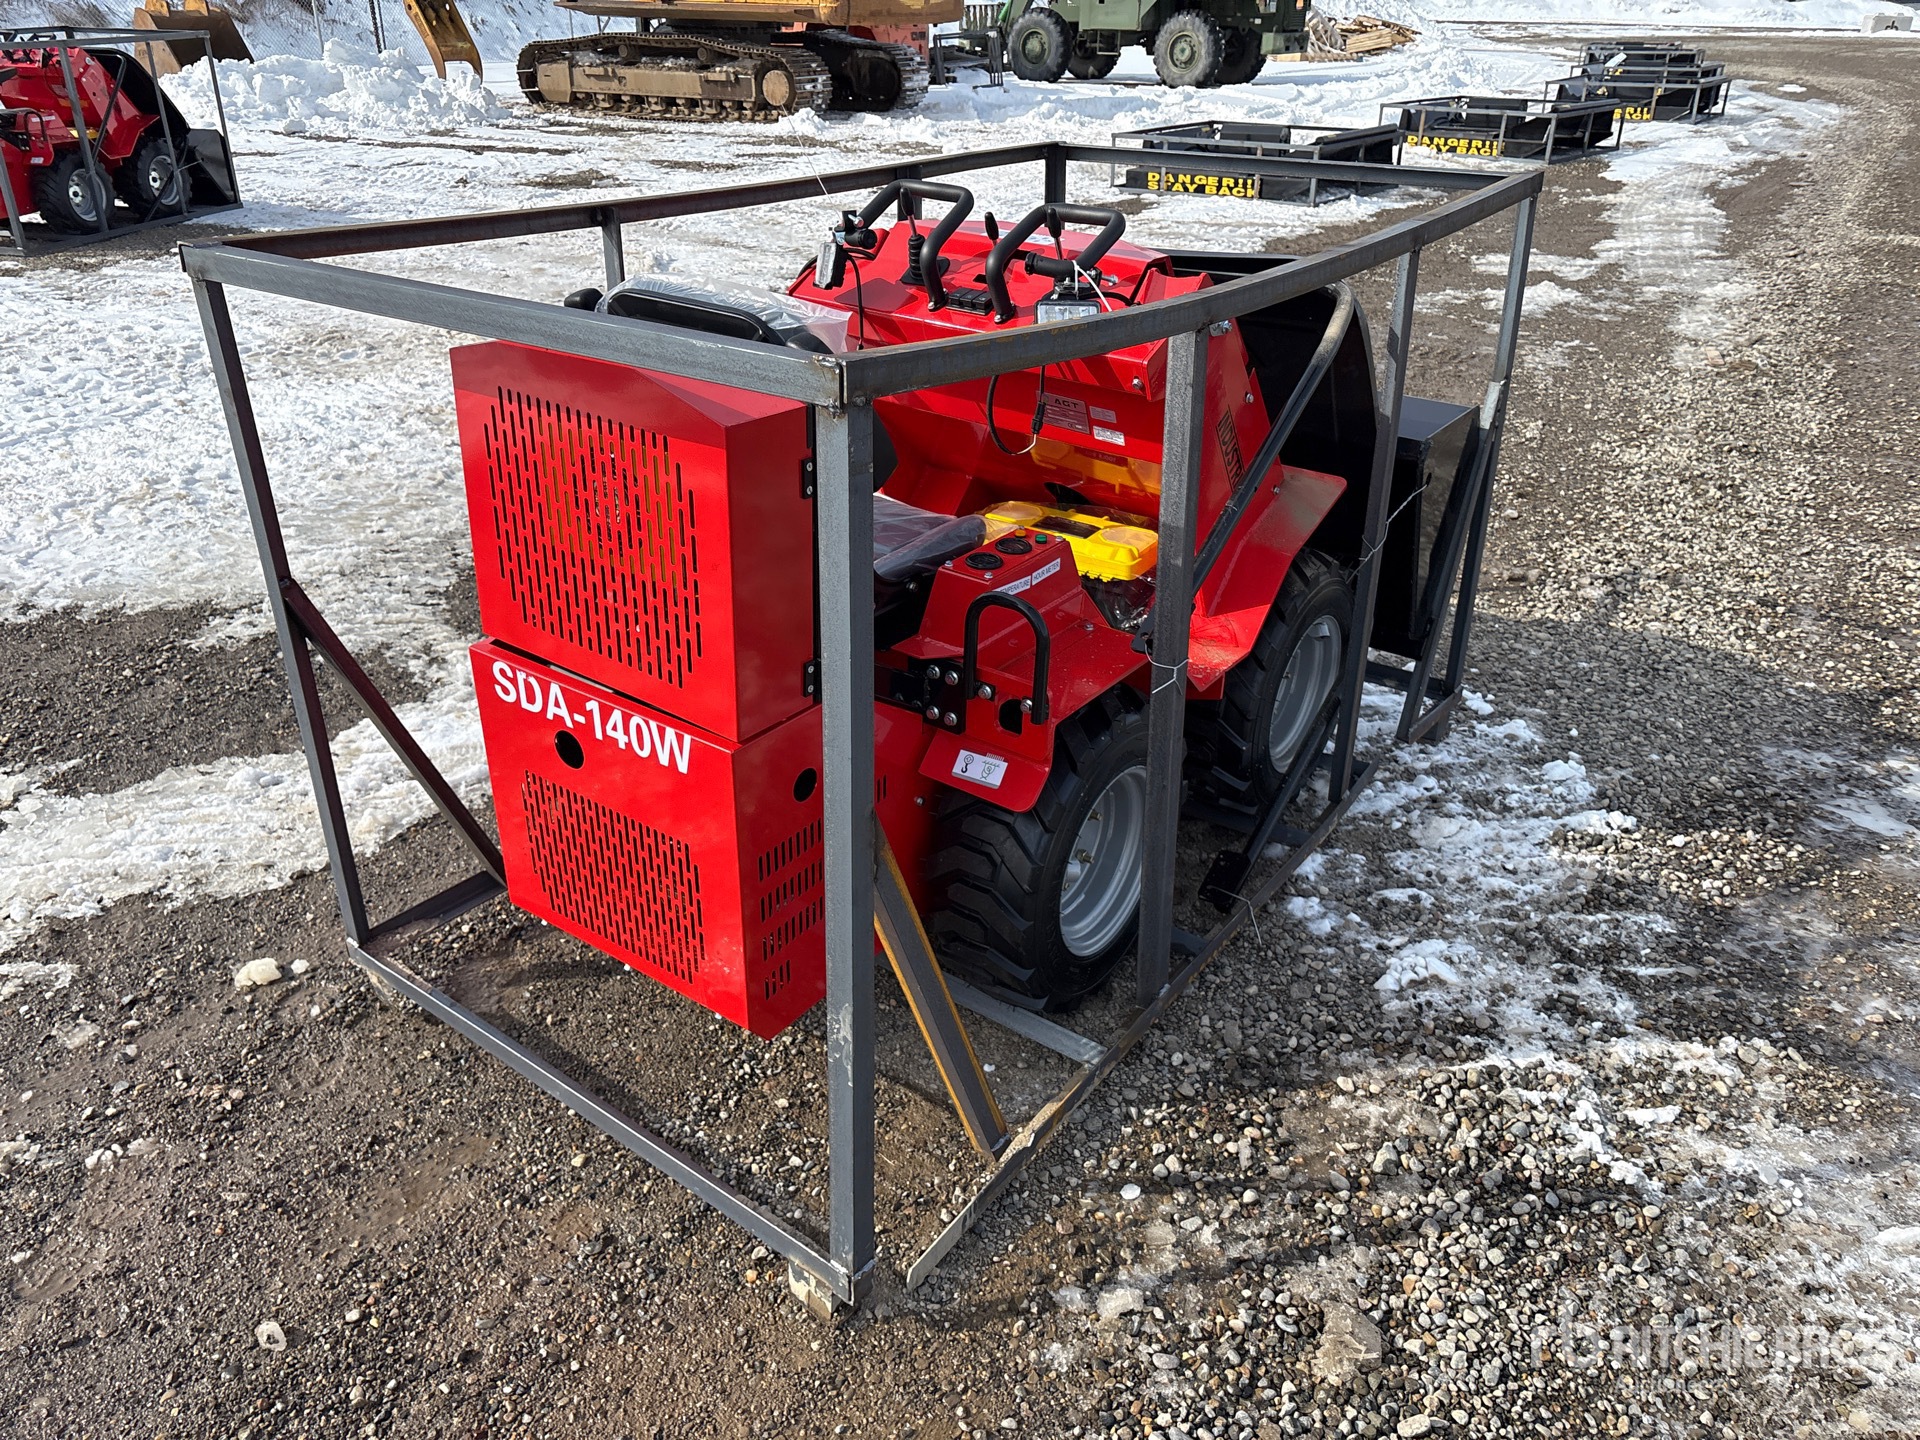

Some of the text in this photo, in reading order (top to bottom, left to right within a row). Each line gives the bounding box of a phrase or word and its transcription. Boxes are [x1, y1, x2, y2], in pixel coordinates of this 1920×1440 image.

[1147, 172, 1257, 189] DANGER!!
[1205, 185, 1257, 198] BACK
[1054, 398, 1079, 409] AGT
[1033, 560, 1060, 581] HOUR METER
[1000, 578, 1030, 594] MPERATURE
[492, 660, 692, 775] SDA-140W
